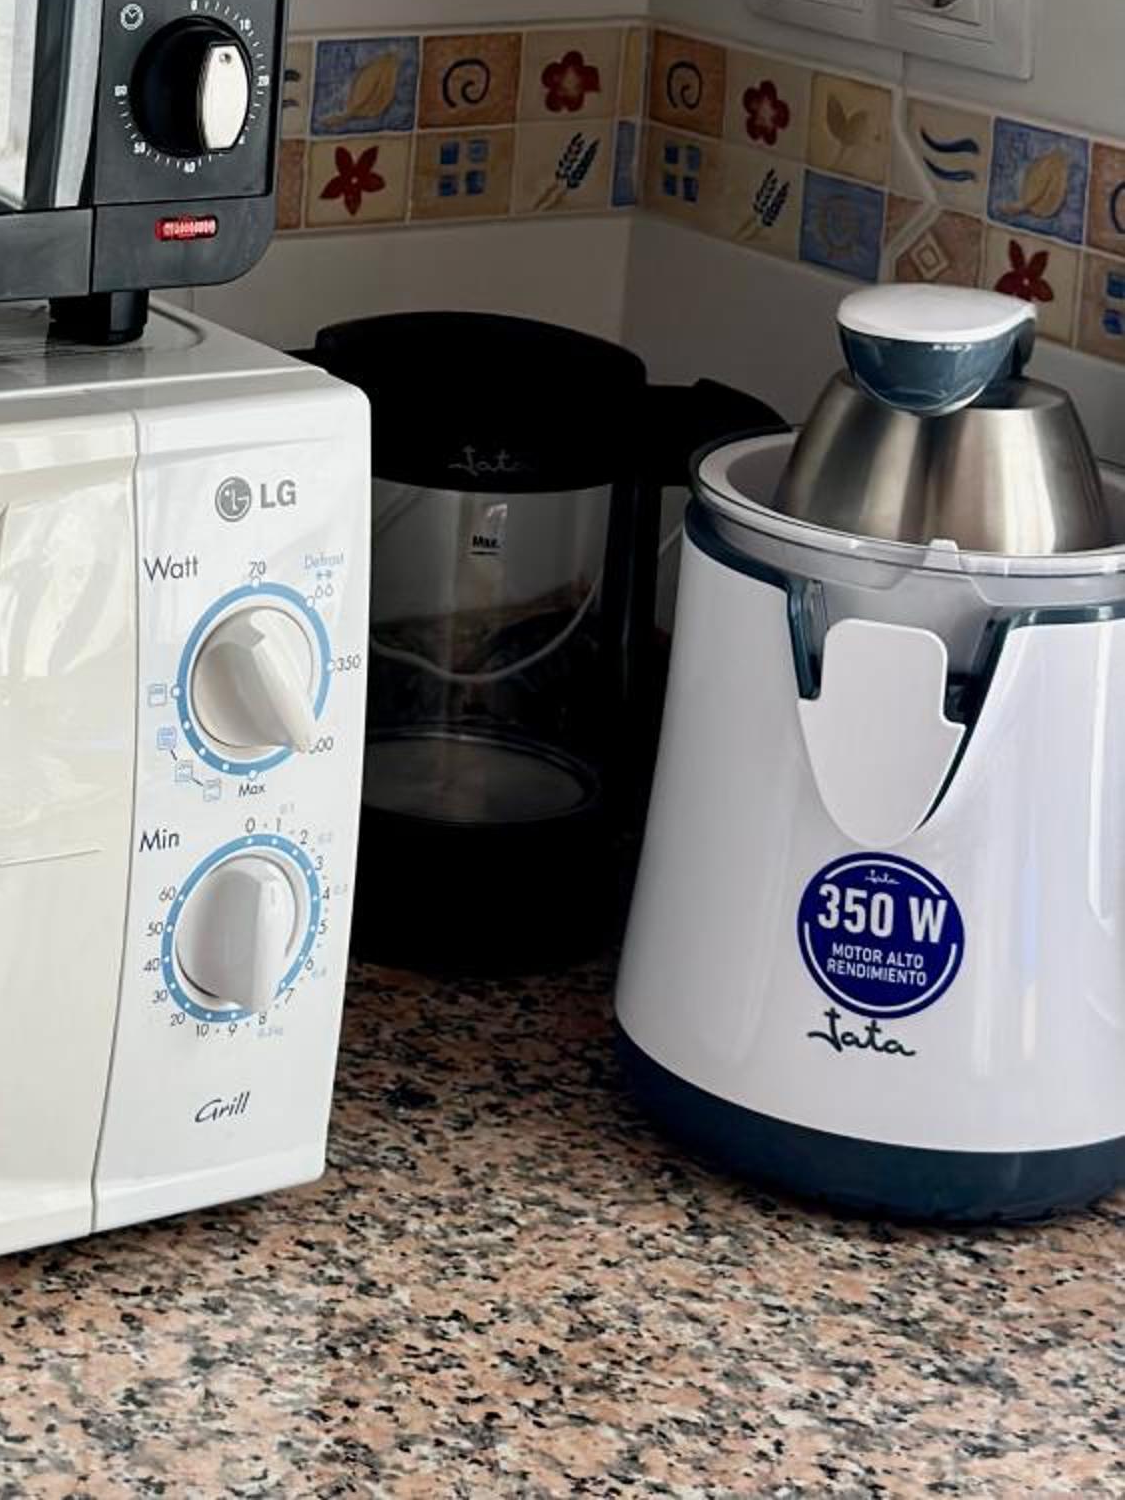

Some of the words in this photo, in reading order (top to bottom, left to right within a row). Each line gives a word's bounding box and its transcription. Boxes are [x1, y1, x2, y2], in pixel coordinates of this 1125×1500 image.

[259, 479, 297, 509] LG
[142, 555, 200, 581] Watt
[248, 560, 267, 577] 70
[336, 654, 362, 673] 350
[238, 782, 266, 798] Max
[244, 816, 257, 834] 0
[138, 828, 181, 853] Min
[299, 828, 309, 845] 2
[314, 854, 324, 871] 3
[321, 885, 331, 901] 4
[816, 883, 895, 938] 350
[908, 896, 948, 944] W
[146, 921, 164, 937] 50
[317, 918, 328, 936] 5
[304, 955, 315, 971] 6
[831, 942, 883, 964] MOTOR
[886, 951, 924, 969] ALTO
[826, 957, 928, 988] RENDIMIENTO
[152, 988, 169, 1005] 30
[283, 986, 295, 1005] 7
[169, 1011, 186, 1028] 20
[195, 1022, 210, 1039] 10
[227, 1021, 238, 1038] 9
[193, 1090, 251, 1124] Grill
